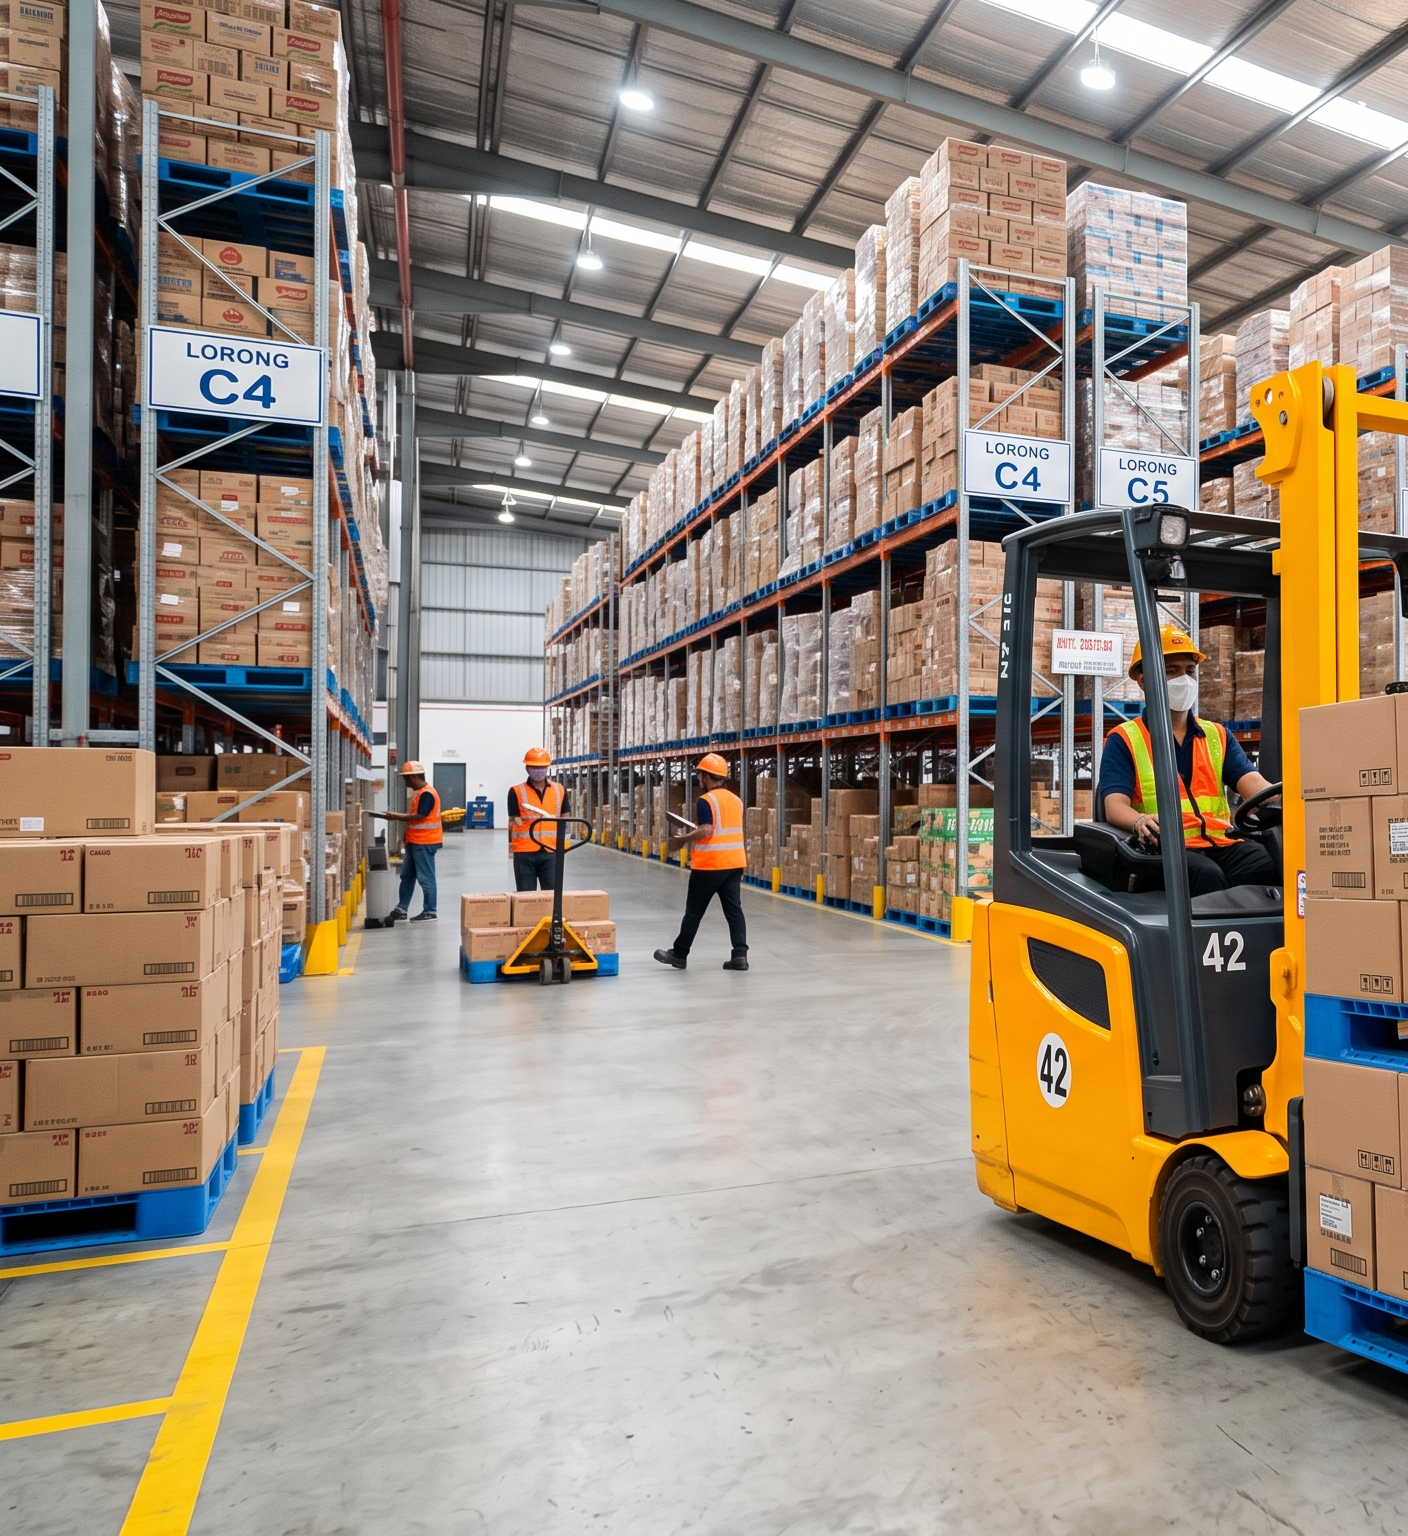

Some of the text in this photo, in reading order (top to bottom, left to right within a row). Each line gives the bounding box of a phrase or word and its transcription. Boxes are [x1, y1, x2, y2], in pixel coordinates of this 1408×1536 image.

[186, 342, 289, 369] LORONG
[199, 368, 276, 409] C4
[985, 441, 1050, 461] LORONG
[995, 461, 1042, 492] C4
[1119, 458, 1178, 476] LORONG
[1127, 477, 1170, 504] C5
[1202, 931, 1247, 973] 42
[1040, 1044, 1067, 1098] 42
